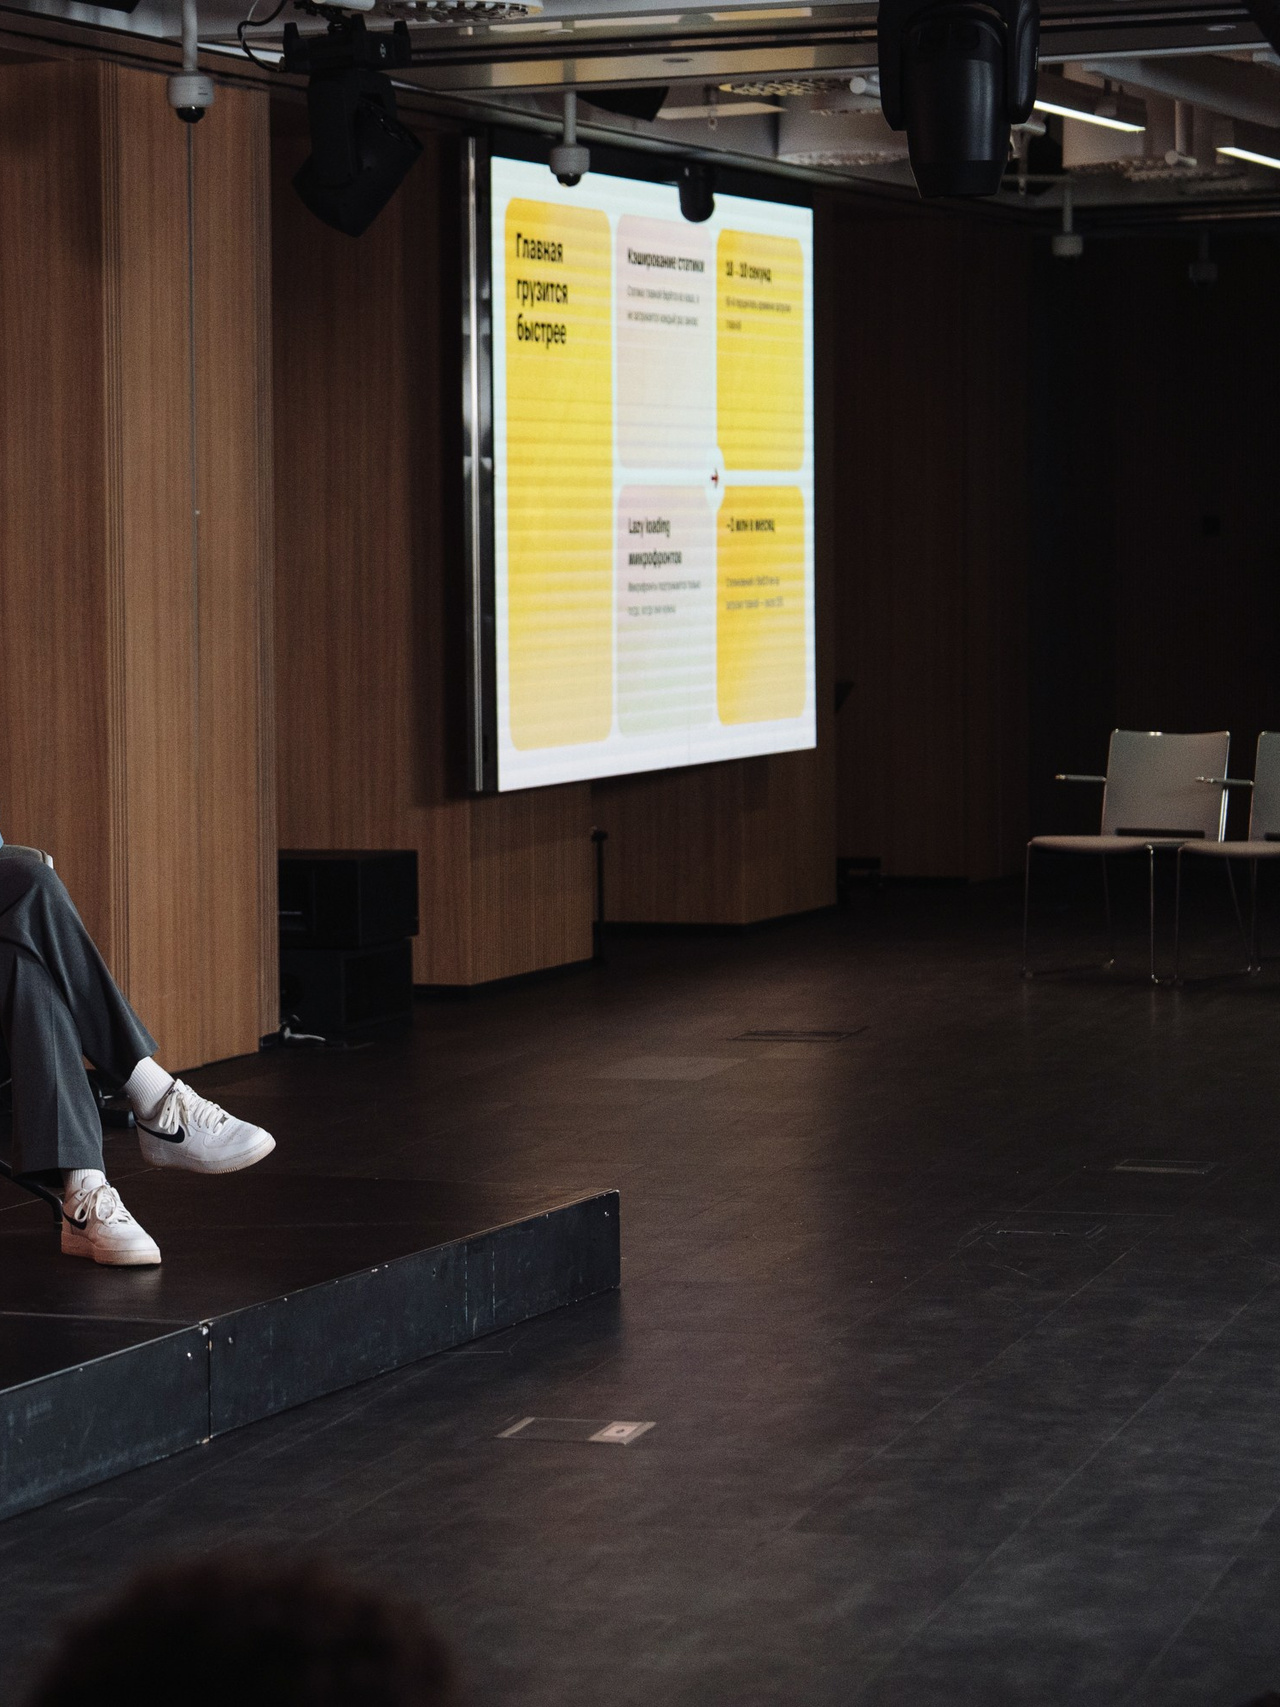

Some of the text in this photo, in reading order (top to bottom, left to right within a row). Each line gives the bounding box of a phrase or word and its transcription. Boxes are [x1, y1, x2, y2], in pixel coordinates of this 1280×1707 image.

[516, 232, 564, 264] Главная
[516, 278, 568, 308] грузится
[517, 313, 567, 349] быстрее
